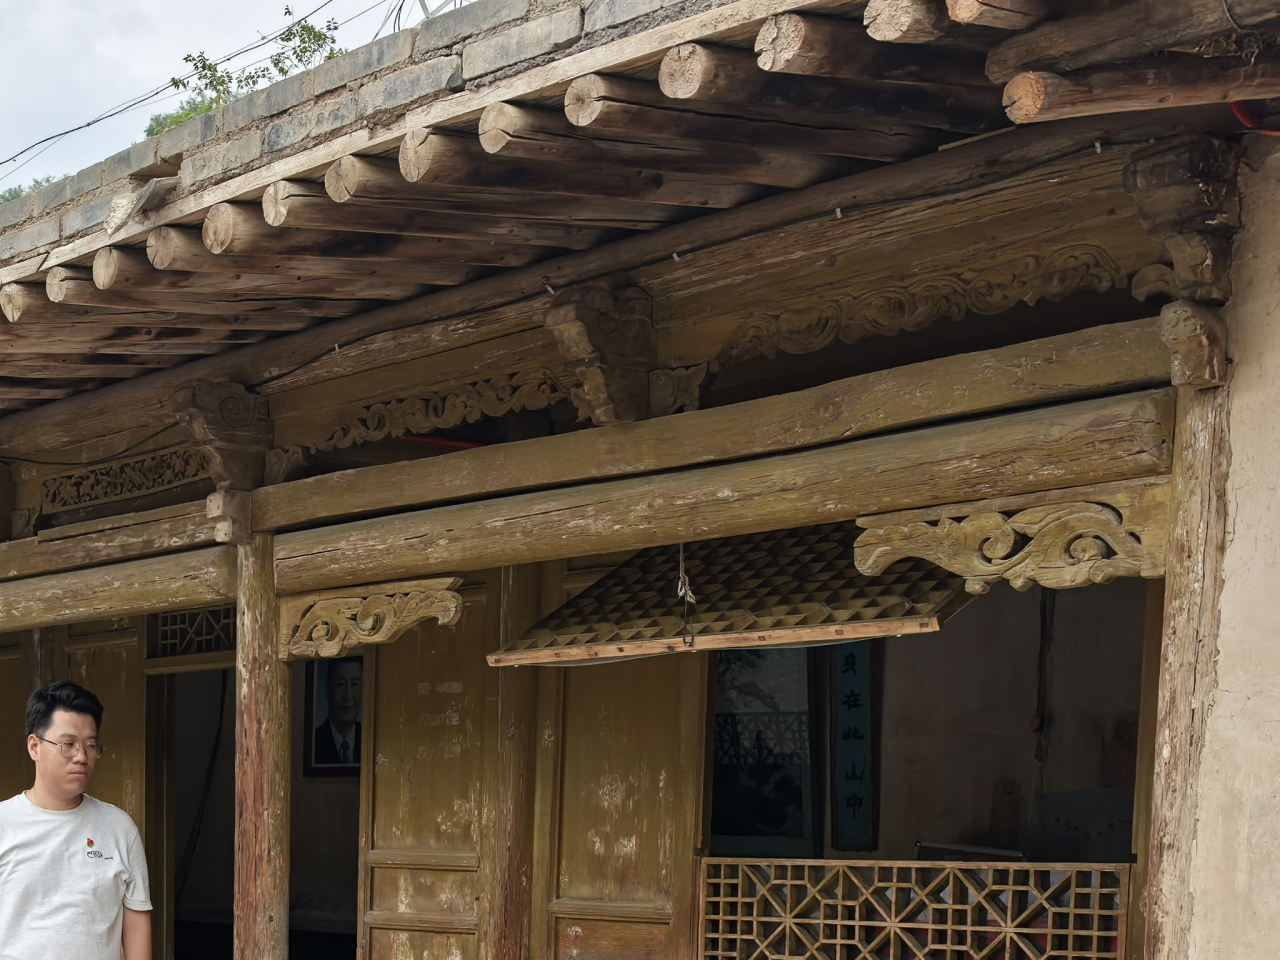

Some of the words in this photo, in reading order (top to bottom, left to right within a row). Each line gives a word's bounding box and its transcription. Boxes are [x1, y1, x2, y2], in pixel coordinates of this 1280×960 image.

[841, 651, 867, 821] 身在此山中
